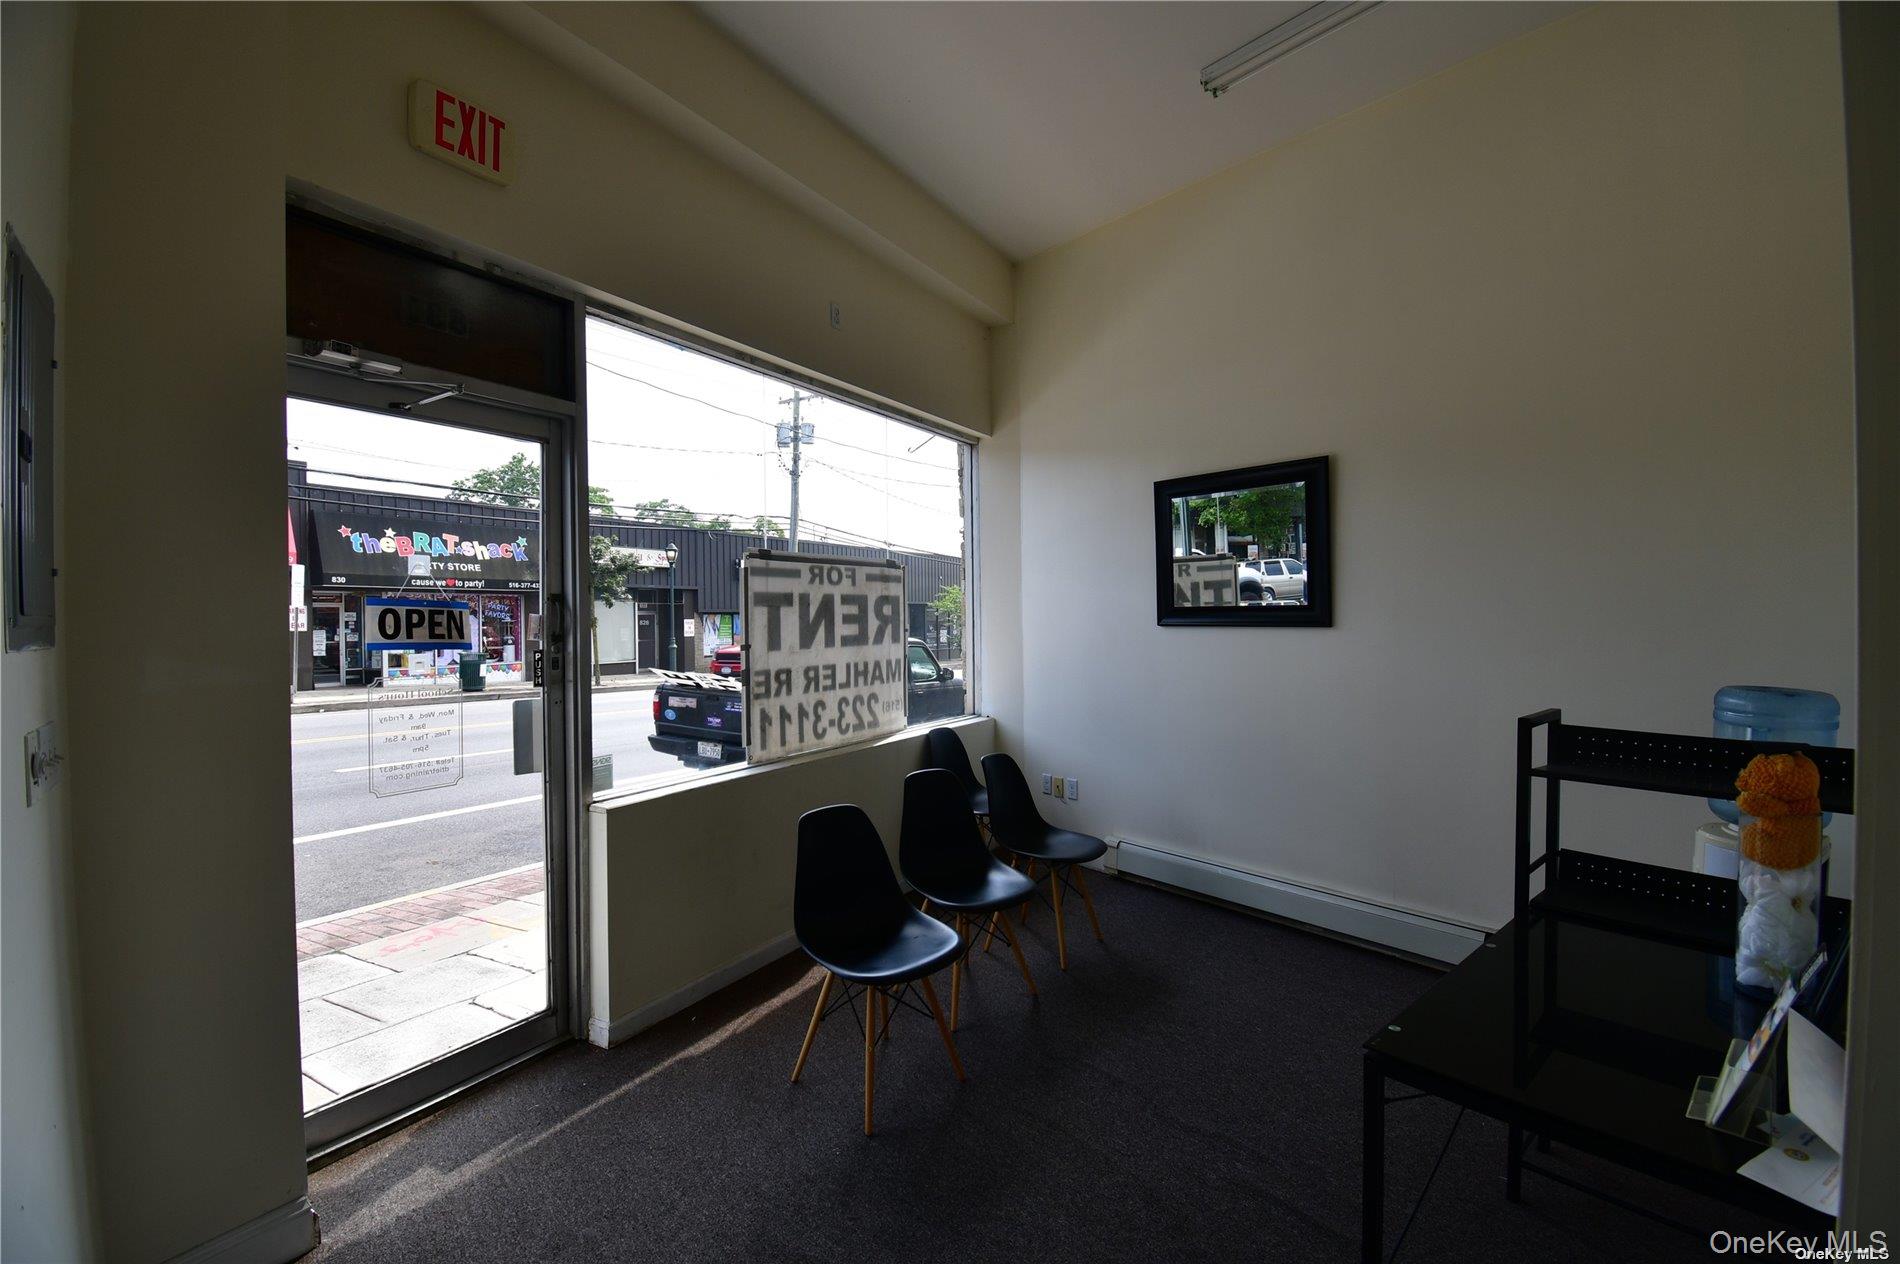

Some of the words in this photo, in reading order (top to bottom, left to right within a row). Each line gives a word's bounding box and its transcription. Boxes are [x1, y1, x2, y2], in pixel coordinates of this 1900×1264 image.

[435, 89, 505, 172] EXIT
[394, 531, 459, 557] BRAT
[461, 541, 528, 561] shack
[447, 562, 482, 572] STORE
[464, 580, 485, 588] party!
[378, 607, 465, 640] OPEN
